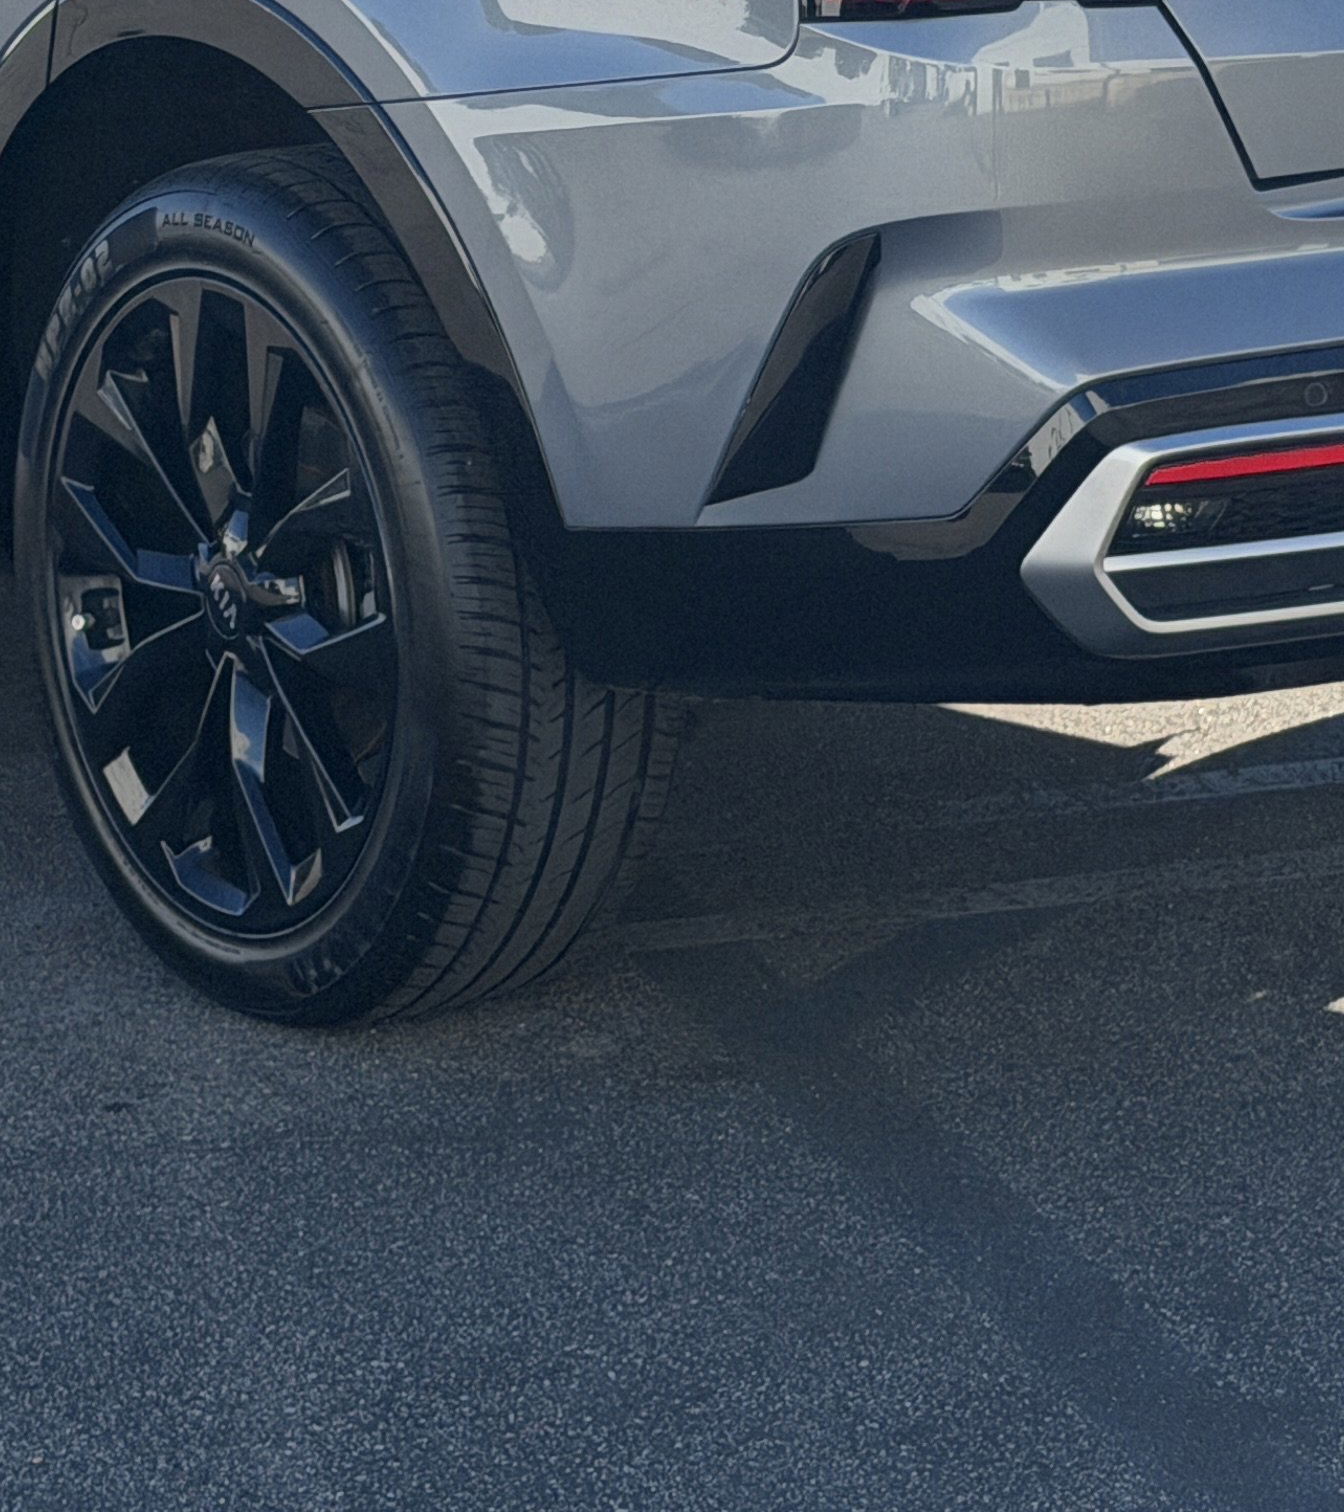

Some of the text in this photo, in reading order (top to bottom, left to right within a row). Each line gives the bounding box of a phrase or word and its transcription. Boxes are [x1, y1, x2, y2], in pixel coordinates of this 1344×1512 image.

[162, 213, 256, 248] ALL SEASON
[210, 573, 237, 630] KIA
